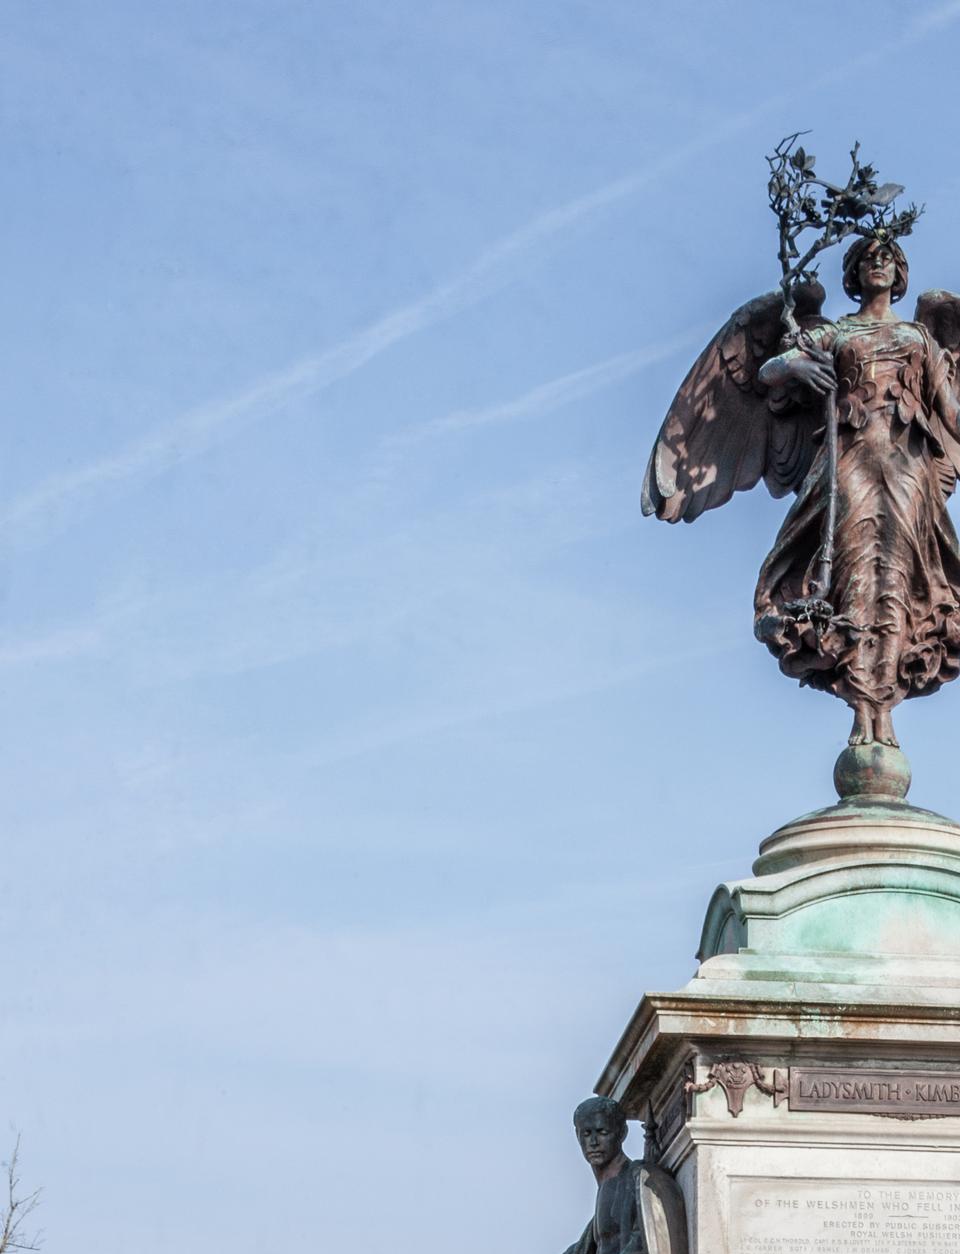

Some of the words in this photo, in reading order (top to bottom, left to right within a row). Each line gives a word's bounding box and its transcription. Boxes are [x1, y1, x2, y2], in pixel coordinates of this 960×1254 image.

[799, 1081, 901, 1101] LADYSMITH
[858, 1190, 871, 1199] TO
[879, 1191, 901, 1200] THE
[908, 1191, 960, 1201] MEMORY
[755, 1199, 770, 1208] OF
[777, 1199, 800, 1209] THE
[806, 1200, 875, 1210] WELSHMEN
[881, 1202, 910, 1211] WHO
[916, 1202, 943, 1211] FELL
[823, 1221, 864, 1229] ERECTED
[870, 1221, 880, 1229] BY
[885, 1222, 917, 1230] PUBLIC
[850, 1230, 877, 1238] ROYAL
[881, 1231, 912, 1239] WELSH
